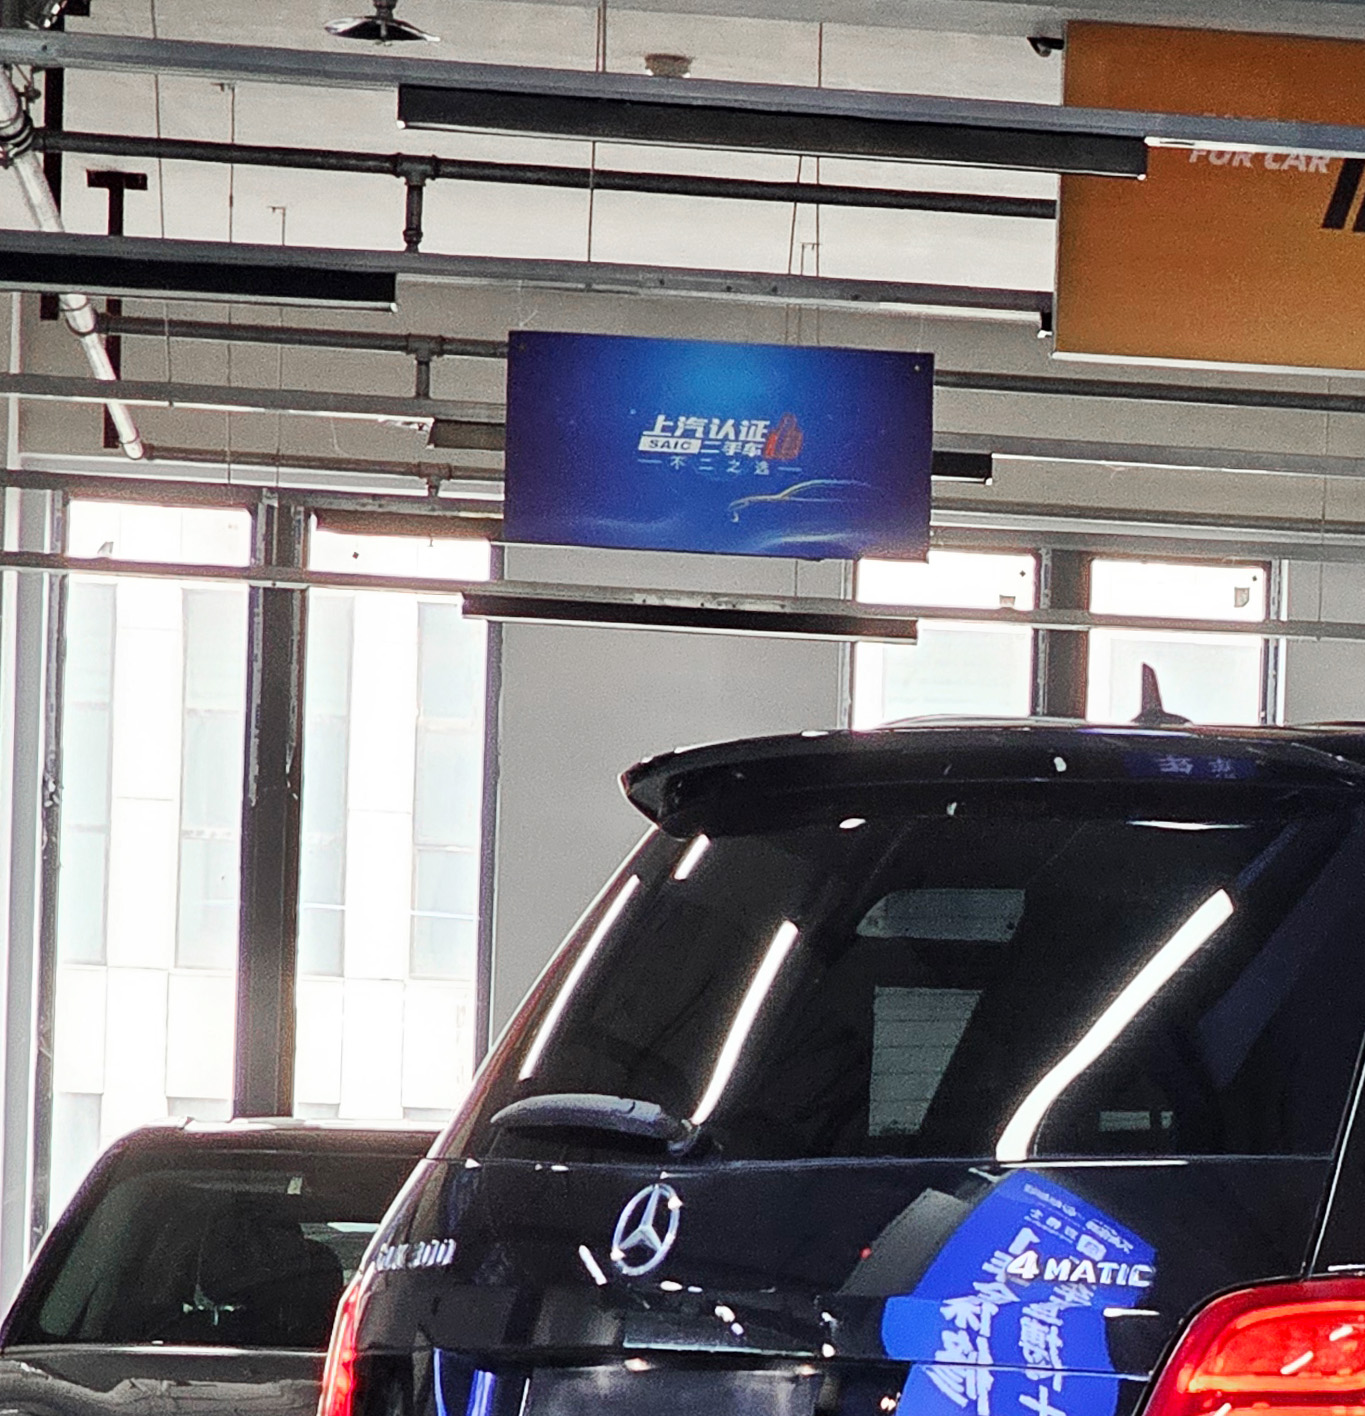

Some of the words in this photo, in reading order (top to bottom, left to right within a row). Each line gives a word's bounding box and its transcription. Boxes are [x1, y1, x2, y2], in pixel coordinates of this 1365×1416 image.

[1263, 151, 1331, 174] CAR
[641, 413, 771, 440] 上汽认证
[648, 440, 692, 450] SAIC
[700, 440, 764, 457] 二手车
[670, 456, 770, 475] 不二之选
[1006, 1250, 1157, 1288] 4MATIC
